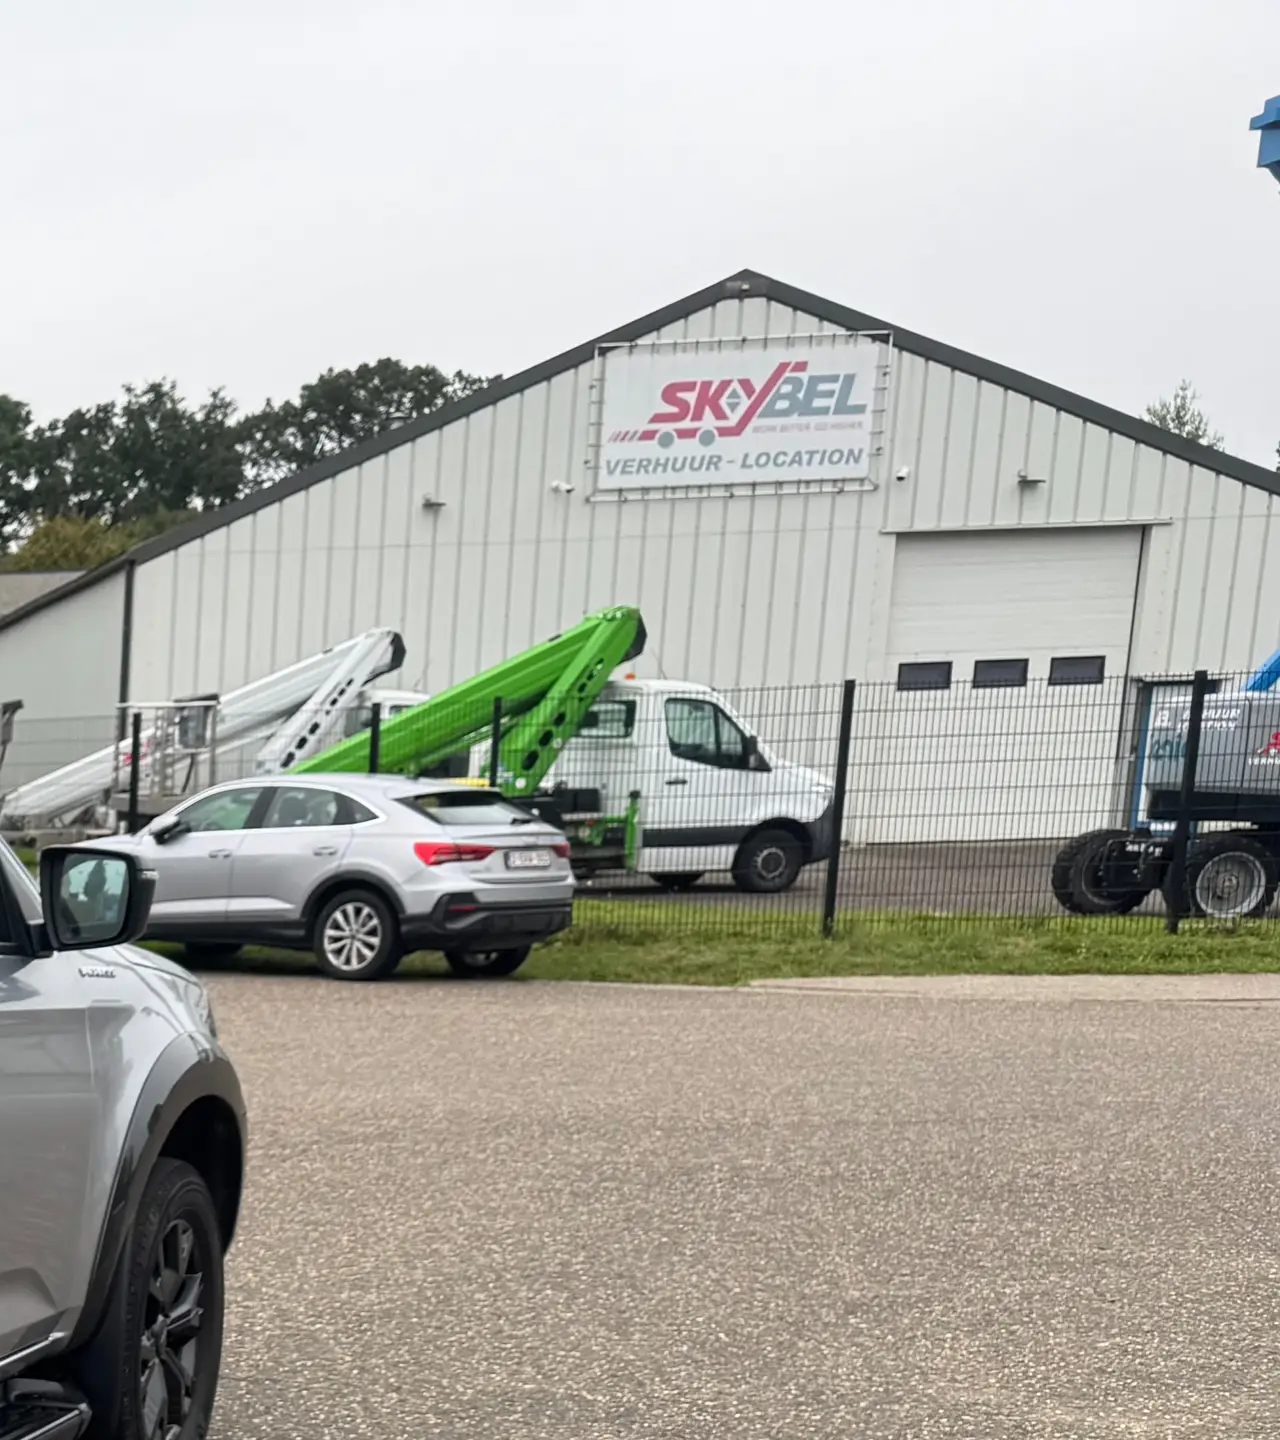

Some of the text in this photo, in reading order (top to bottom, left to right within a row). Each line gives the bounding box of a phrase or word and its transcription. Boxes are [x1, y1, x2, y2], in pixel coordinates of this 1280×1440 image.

[648, 361, 868, 432] SKYBEL
[605, 454, 723, 476] VERHUUR
[740, 448, 865, 470] LOCATION
